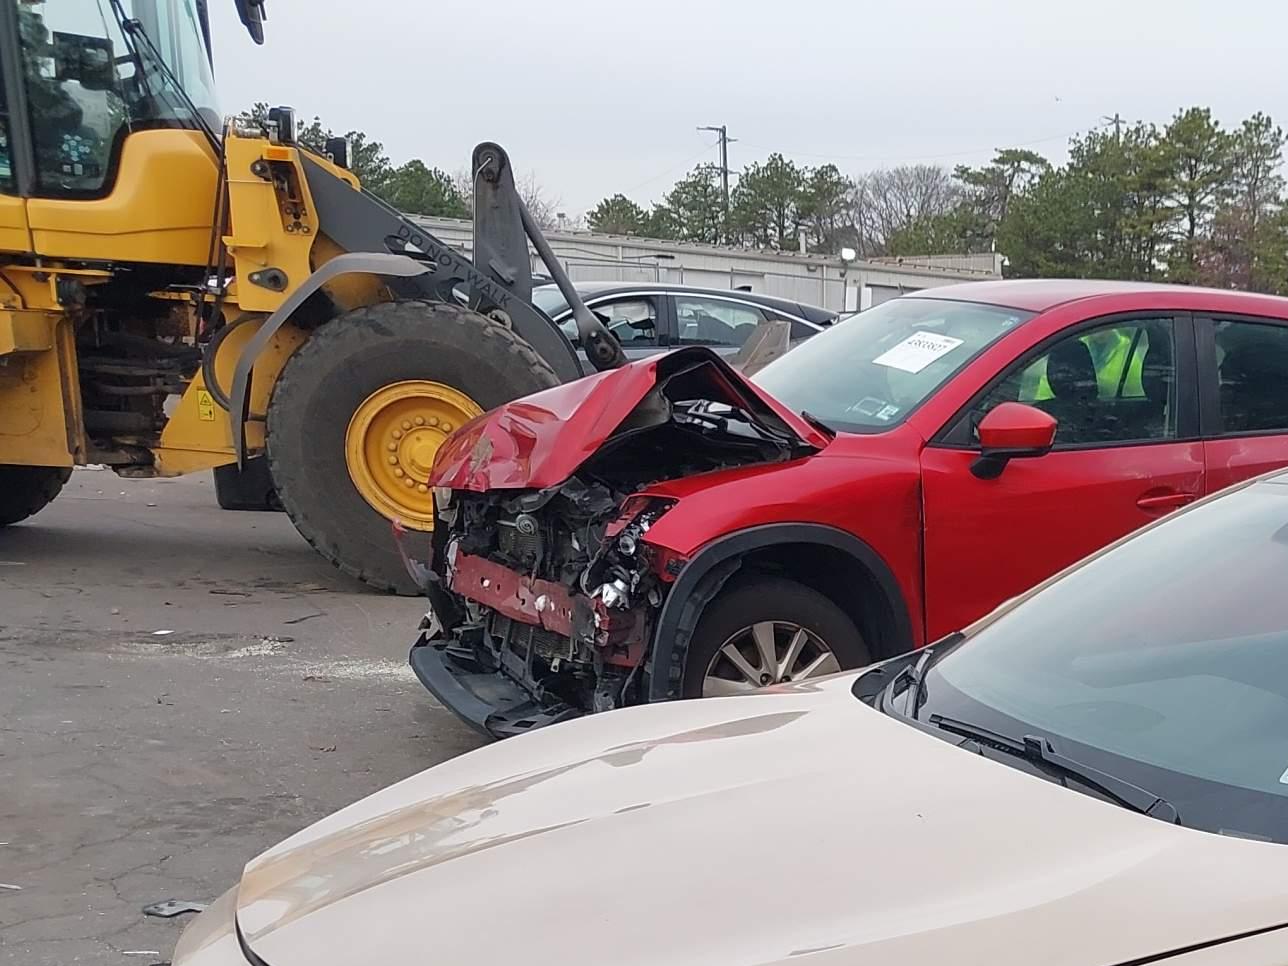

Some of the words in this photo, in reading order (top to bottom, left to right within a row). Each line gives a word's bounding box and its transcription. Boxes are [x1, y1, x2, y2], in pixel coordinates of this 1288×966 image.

[399, 226, 423, 246] DO
[426, 245, 463, 274] NOT
[467, 271, 513, 308] WALK
